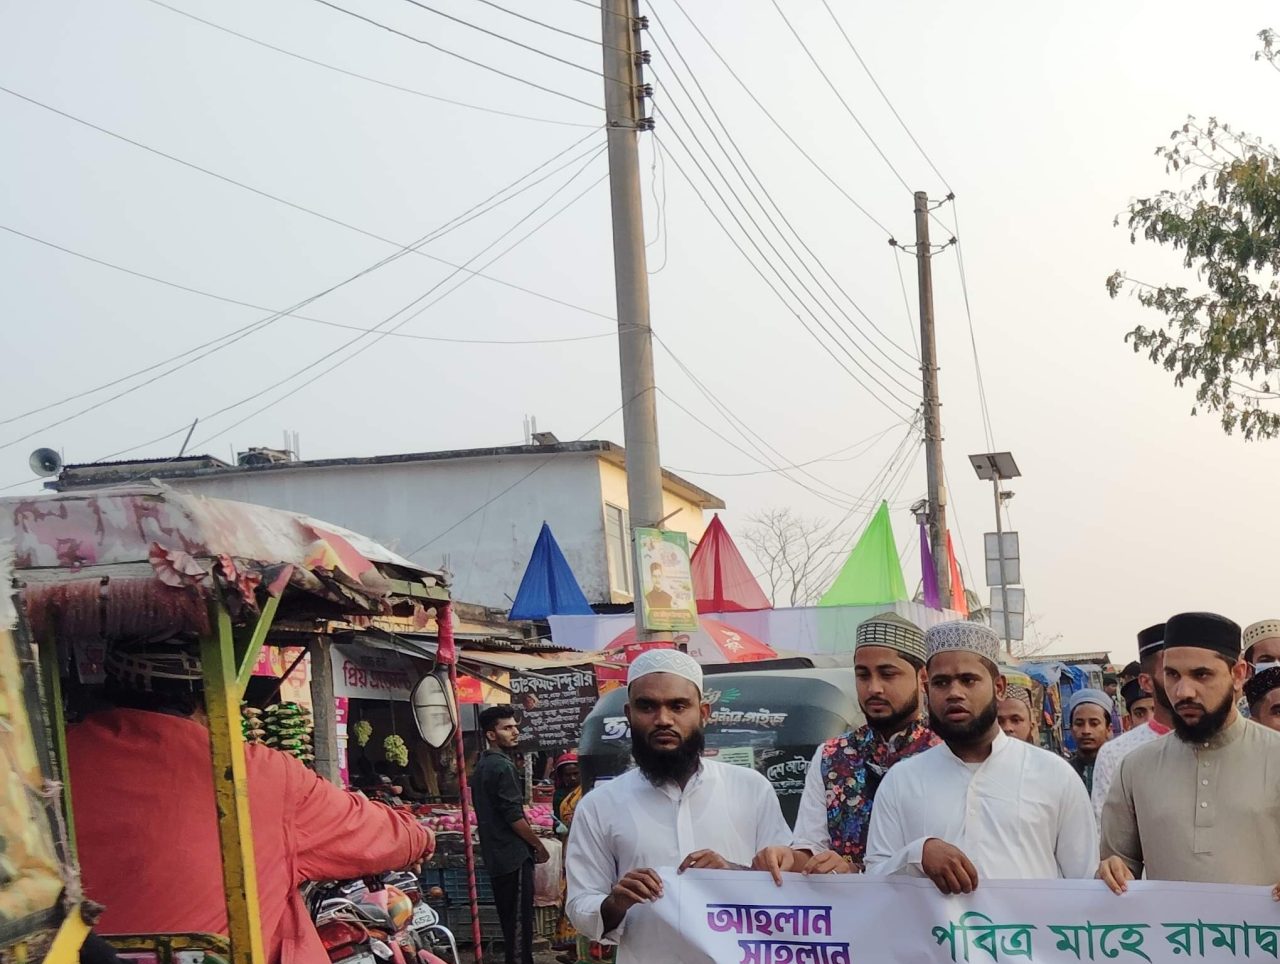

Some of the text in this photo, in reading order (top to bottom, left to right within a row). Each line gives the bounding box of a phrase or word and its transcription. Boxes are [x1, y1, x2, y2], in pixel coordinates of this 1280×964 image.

[707, 903, 832, 938] আহলান
[931, 910, 1038, 963] পবিত্র
[1049, 921, 1152, 964] মাহে
